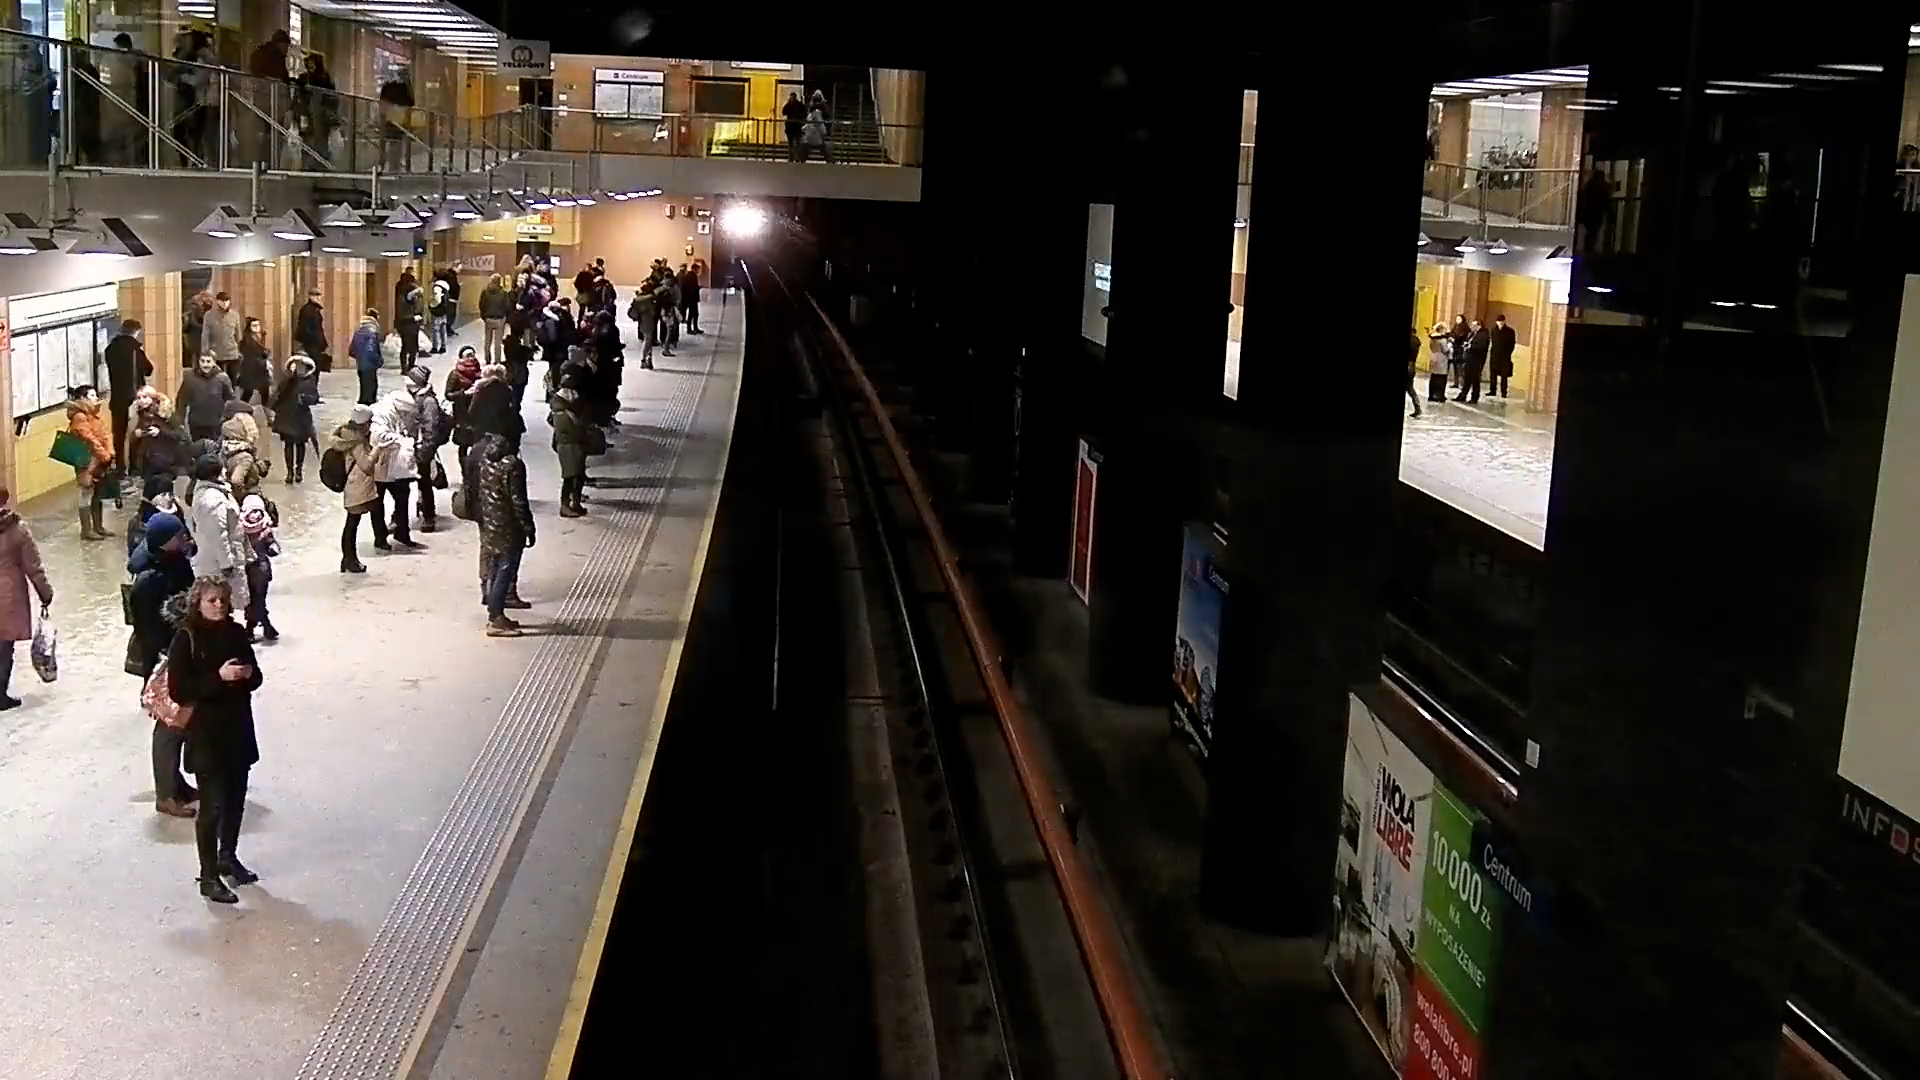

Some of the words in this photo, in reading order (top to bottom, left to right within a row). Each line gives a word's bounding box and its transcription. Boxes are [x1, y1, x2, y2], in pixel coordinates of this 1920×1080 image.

[1381, 766, 1415, 832] WOLA
[1376, 804, 1414, 872] LIBRE
[1483, 843, 1533, 913] Centrum
[1448, 903, 1461, 929] NA
[1413, 1023, 1431, 1059] 800
[1416, 990, 1473, 1078] wolalibre.pl
